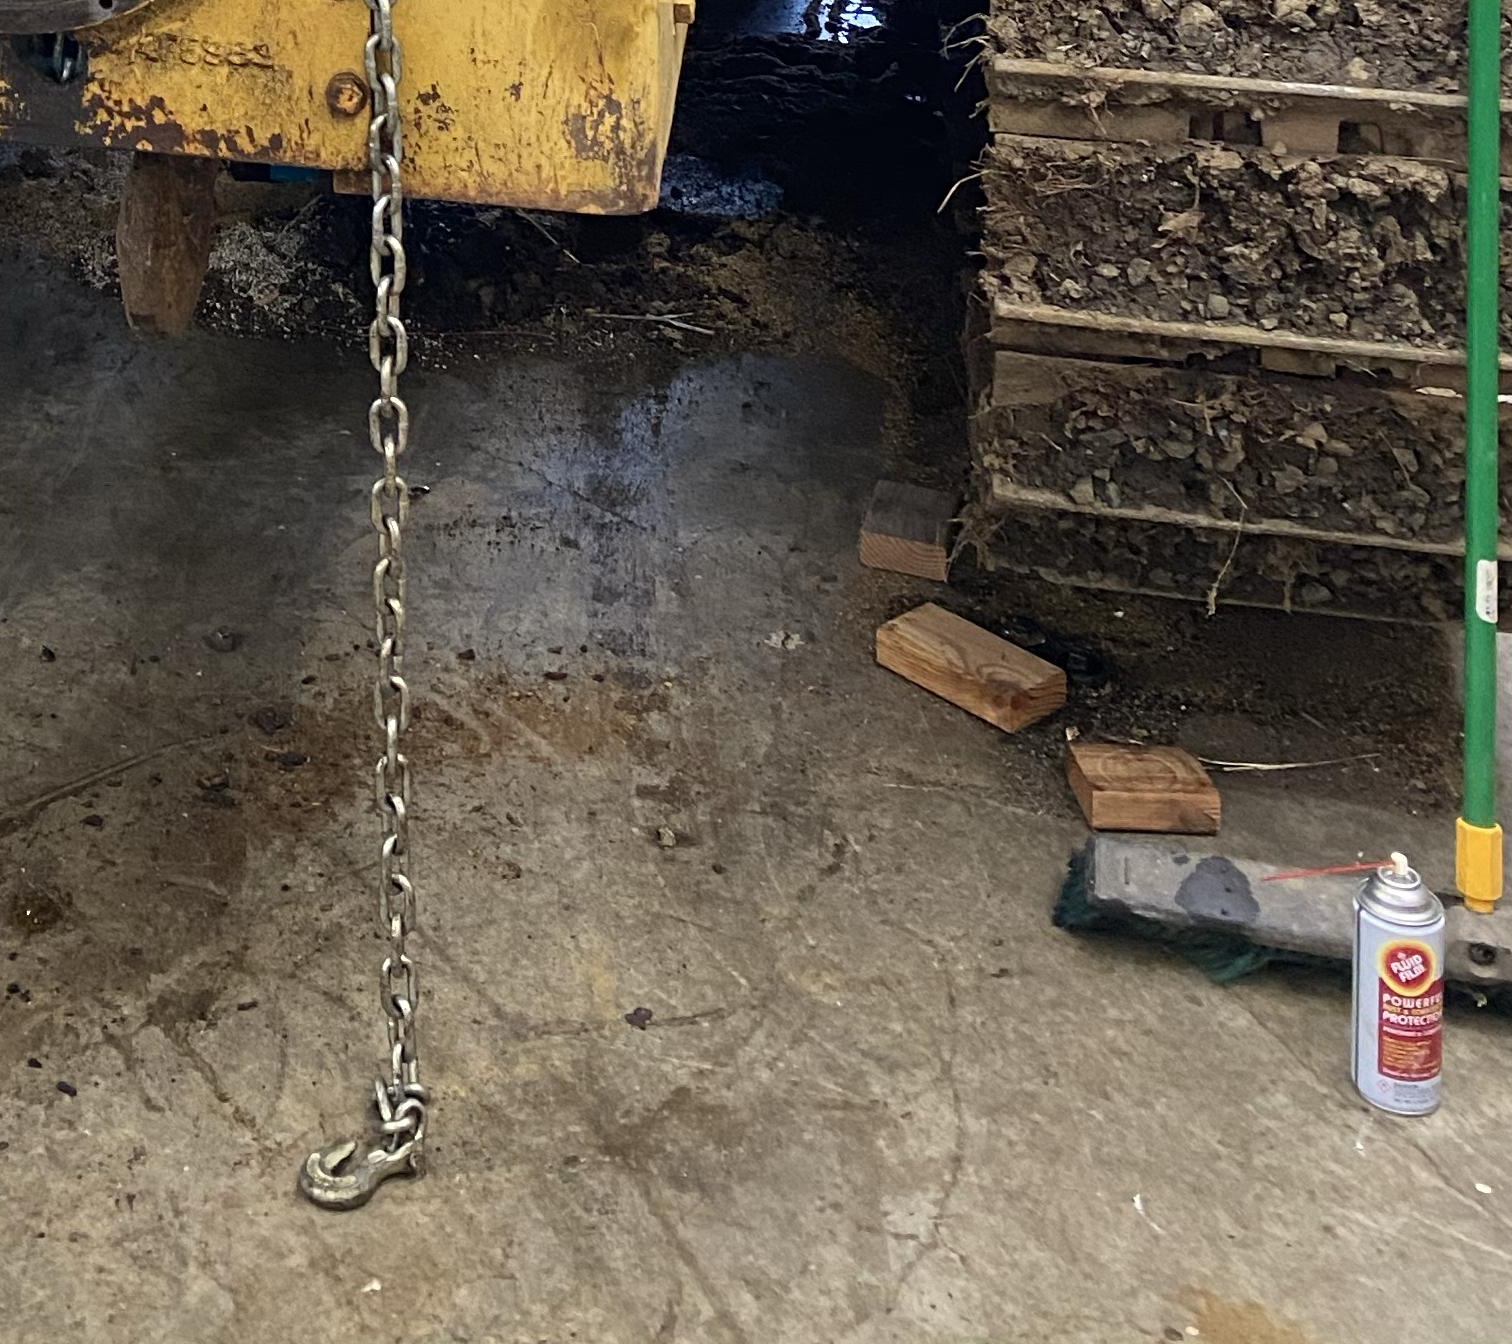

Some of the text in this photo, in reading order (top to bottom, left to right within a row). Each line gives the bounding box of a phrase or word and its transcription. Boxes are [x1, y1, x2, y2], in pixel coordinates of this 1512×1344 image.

[1390, 954, 1424, 974] FLUID
[1398, 963, 1427, 983] FILM
[1382, 993, 1444, 1009] POWERFU
[1382, 1010, 1444, 1026] PROTECTIO
